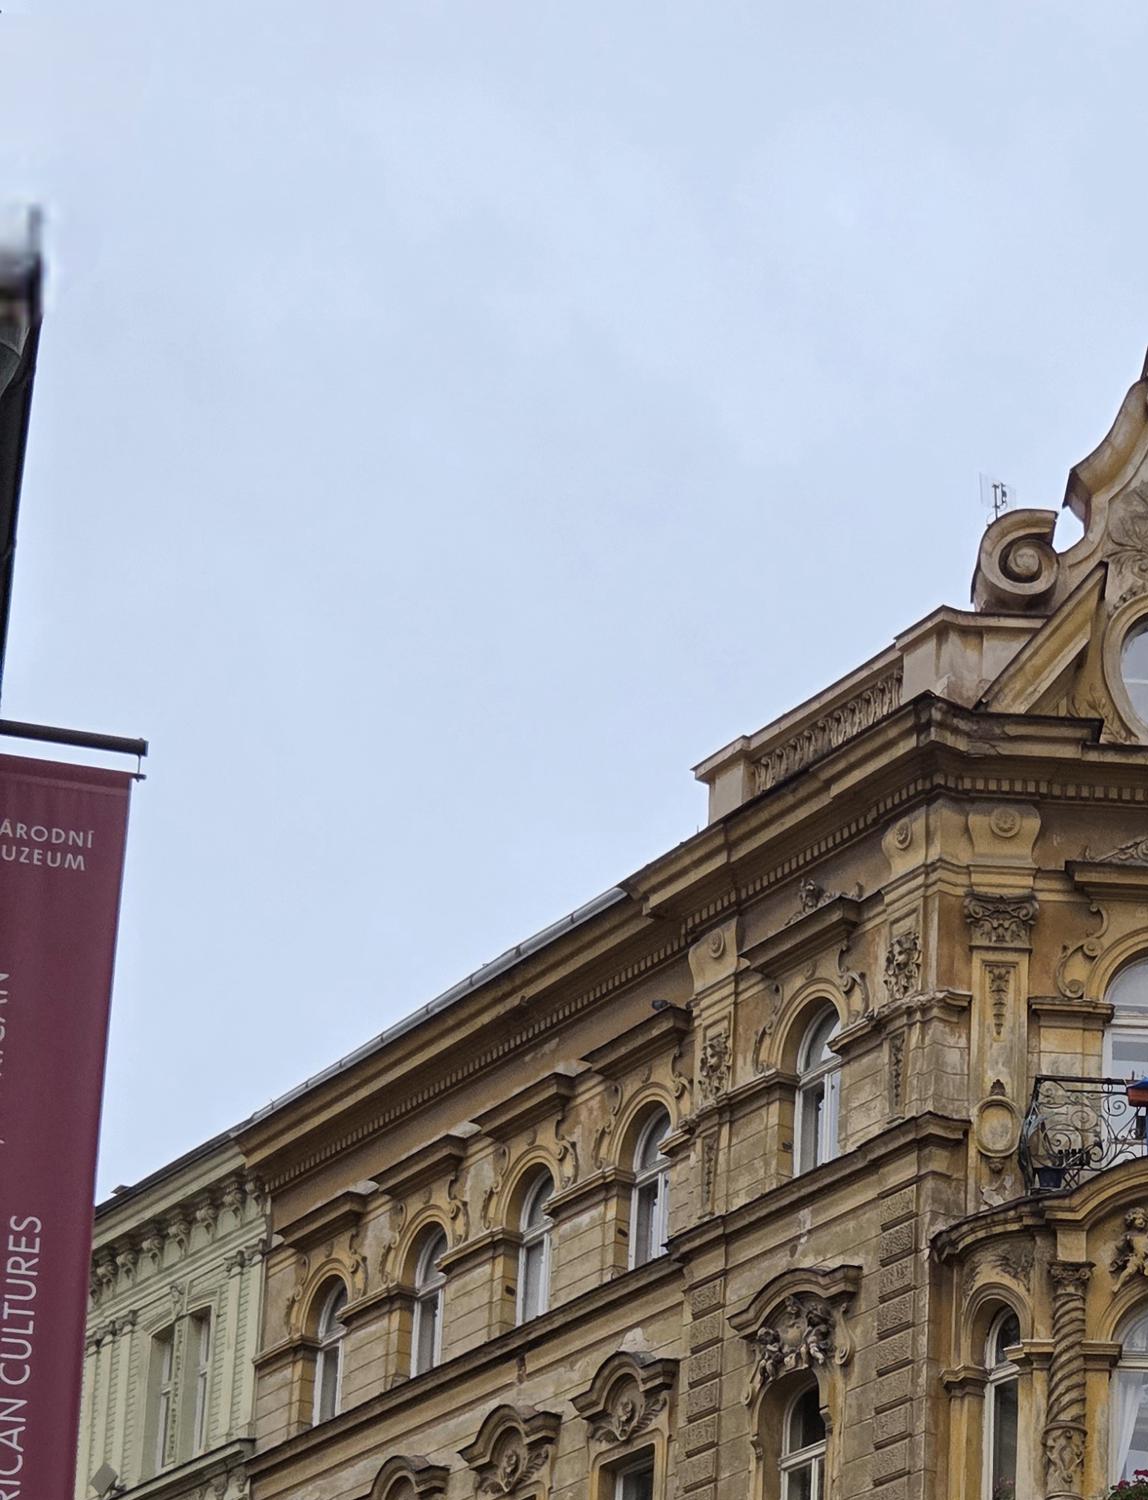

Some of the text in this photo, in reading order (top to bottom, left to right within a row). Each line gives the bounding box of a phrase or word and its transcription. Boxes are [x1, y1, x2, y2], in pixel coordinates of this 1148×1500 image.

[0, 819, 94, 848] ÁRODNÍ
[0, 845, 85, 870] UZEUM
[0, 1215, 42, 1385] CULTURES
